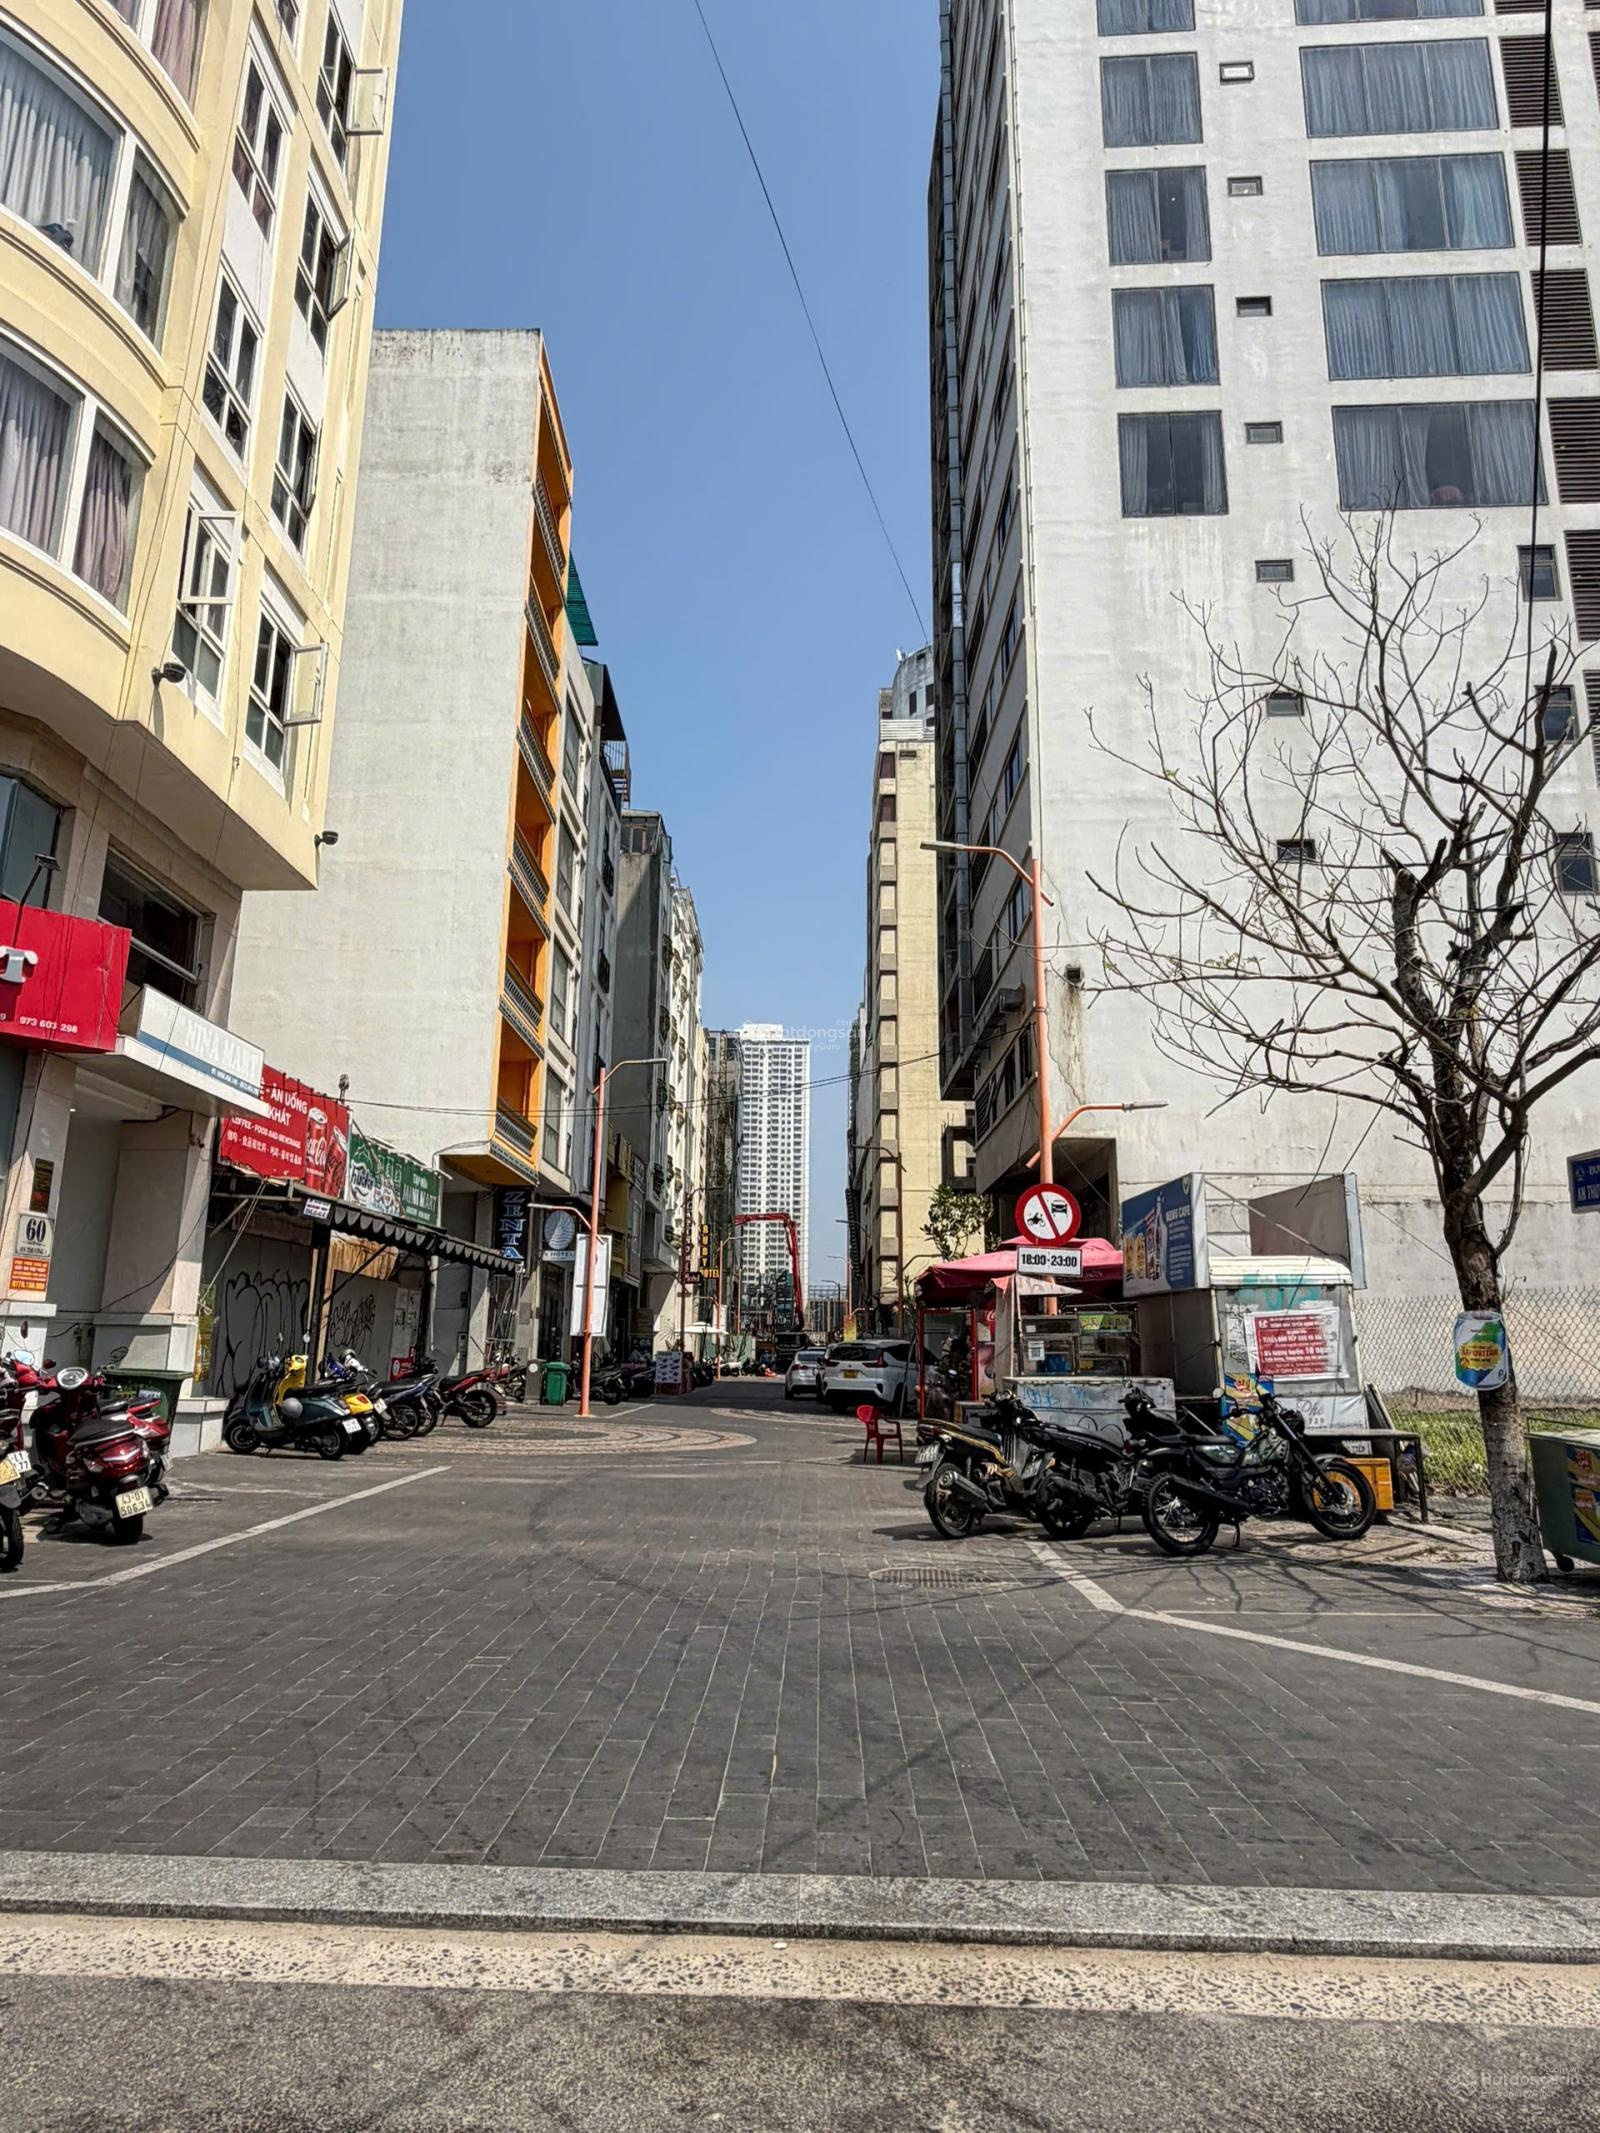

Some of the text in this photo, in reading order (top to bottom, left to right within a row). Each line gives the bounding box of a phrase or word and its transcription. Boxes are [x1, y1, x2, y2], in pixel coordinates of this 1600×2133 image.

[19, 1016, 37, 1026] 973
[39, 1019, 57, 1030] 603
[26, 1218, 47, 1242] 60
[701, 1224, 709, 1267] RUBY
